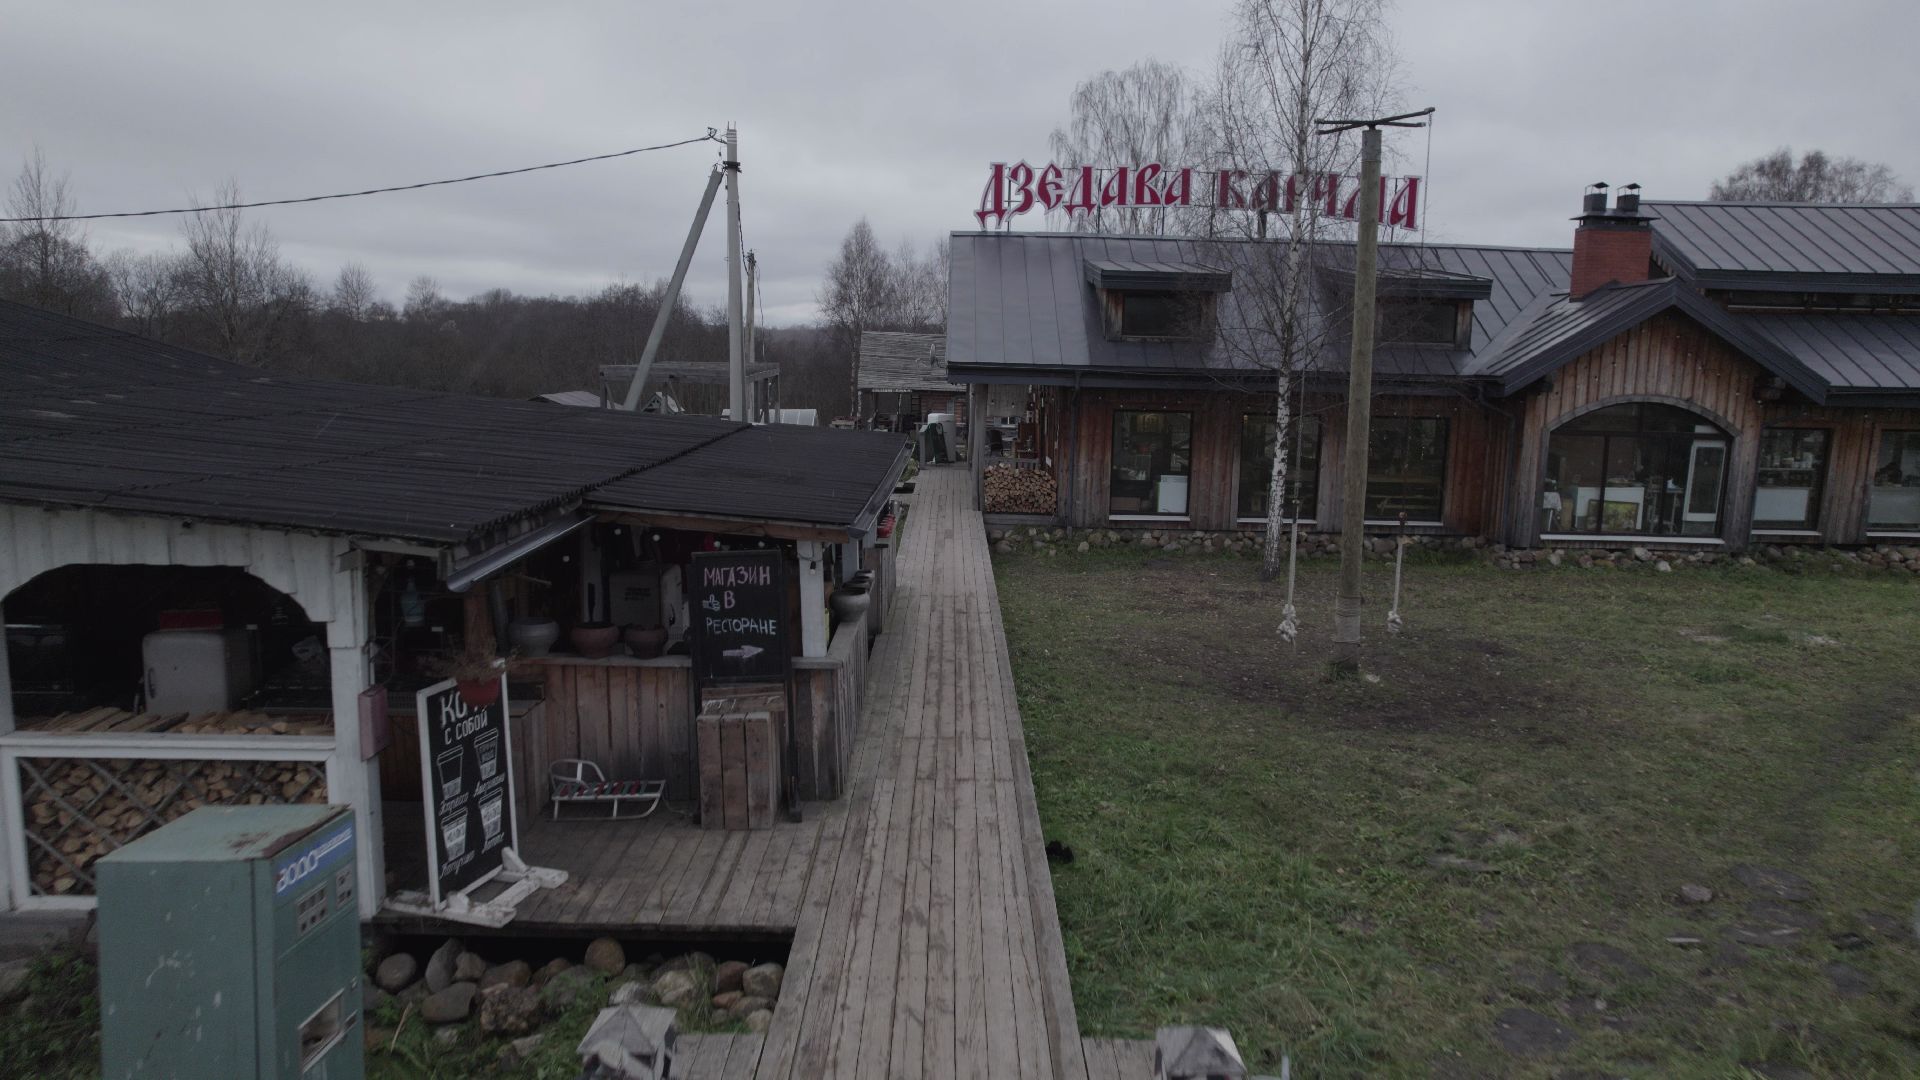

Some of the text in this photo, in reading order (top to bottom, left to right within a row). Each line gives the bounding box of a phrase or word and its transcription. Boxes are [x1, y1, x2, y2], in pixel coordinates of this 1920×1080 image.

[973, 159, 1193, 230] ДЗЕДАВА
[703, 565, 771, 587] МАГАЗИН
[723, 590, 736, 609] В
[705, 616, 777, 636] РЕСТОРАНЕ
